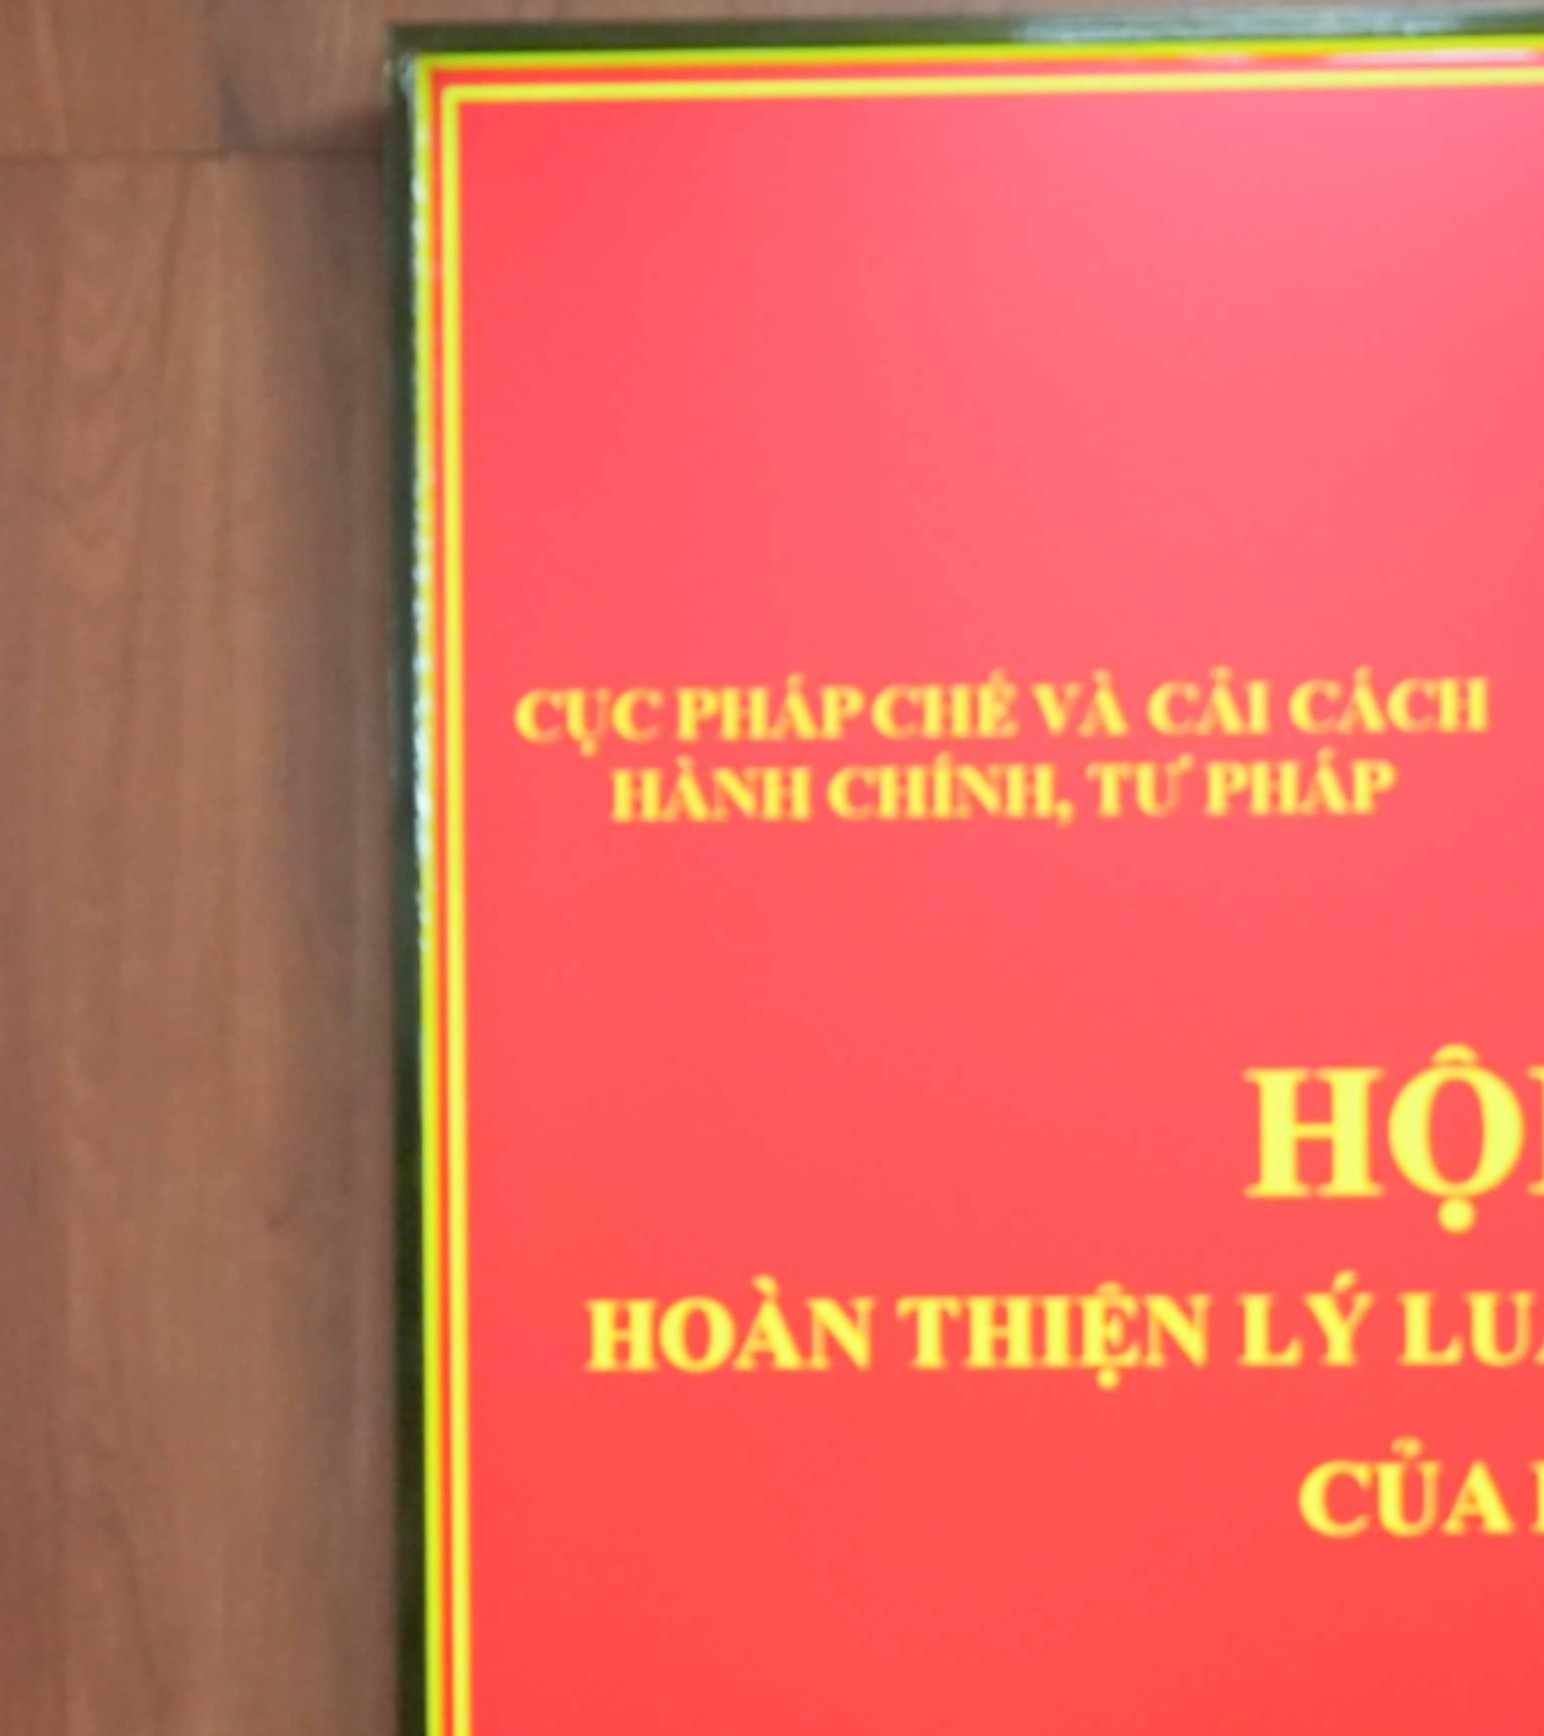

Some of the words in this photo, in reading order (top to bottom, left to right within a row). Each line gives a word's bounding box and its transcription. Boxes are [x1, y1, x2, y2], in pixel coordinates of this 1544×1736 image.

[515, 689, 662, 756] CỤC
[678, 674, 864, 741] PHÁP
[1033, 671, 1128, 736] VÀ
[1148, 667, 1268, 734] CẢI
[1289, 667, 1487, 732] CÁCH
[613, 756, 810, 822] HÀNH
[827, 753, 1073, 823] CHÍNH,
[1087, 754, 1192, 816] TƯ
[1207, 748, 1395, 815] PHÁP
[588, 1276, 873, 1372] HOÀN
[897, 1282, 1209, 1389] THIỆN
[1241, 1271, 1372, 1366] LÝ
[1299, 1438, 1513, 1536] CỦA
